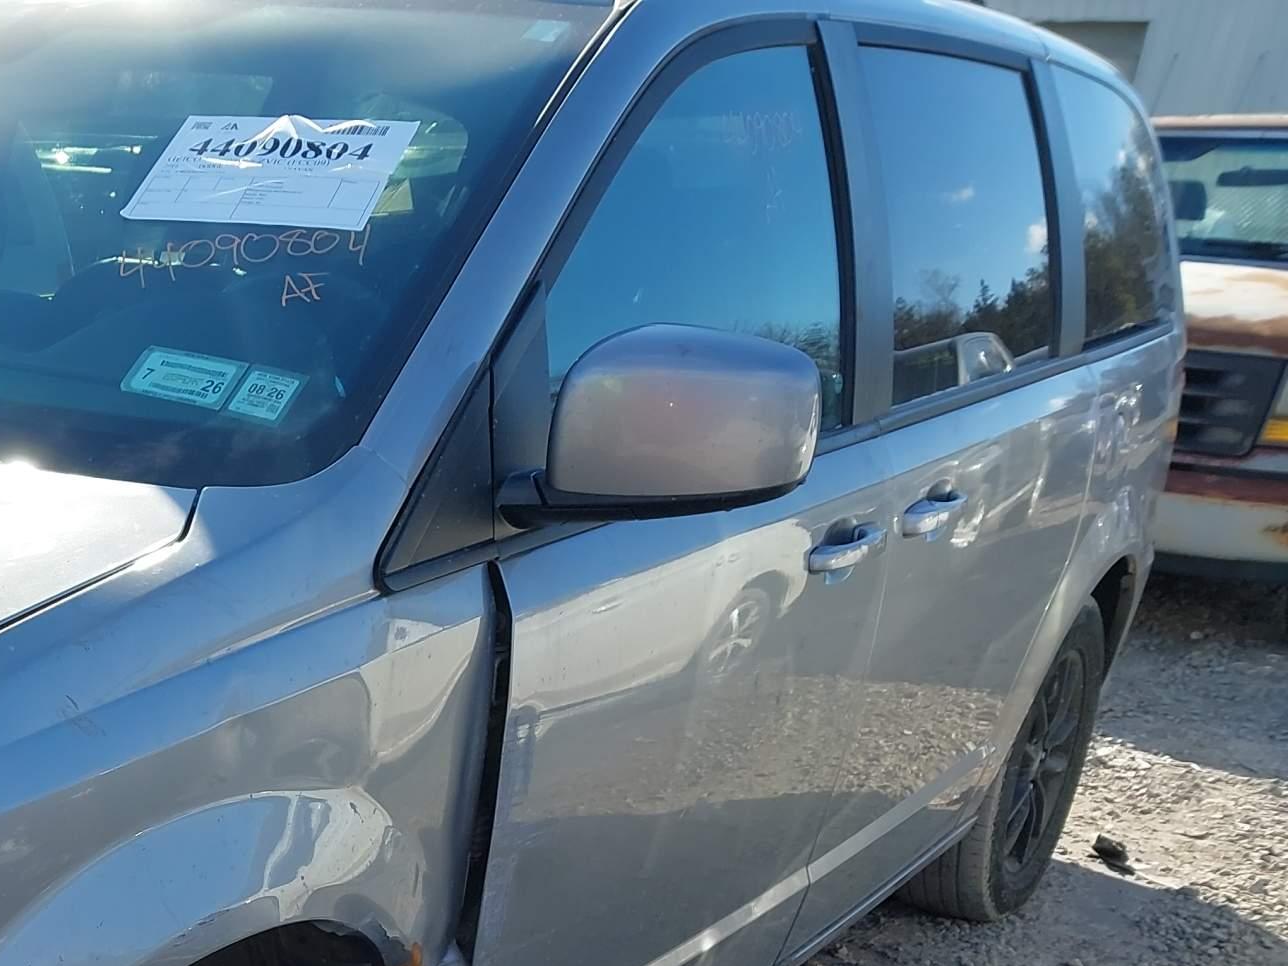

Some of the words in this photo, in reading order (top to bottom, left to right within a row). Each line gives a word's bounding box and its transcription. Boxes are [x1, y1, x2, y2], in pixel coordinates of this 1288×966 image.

[189, 137, 373, 160] 44090804
[119, 224, 372, 288] 44090804
[281, 272, 329, 306] AF
[142, 367, 156, 380] 7
[200, 379, 225, 394] 26
[267, 387, 286, 400] 26
